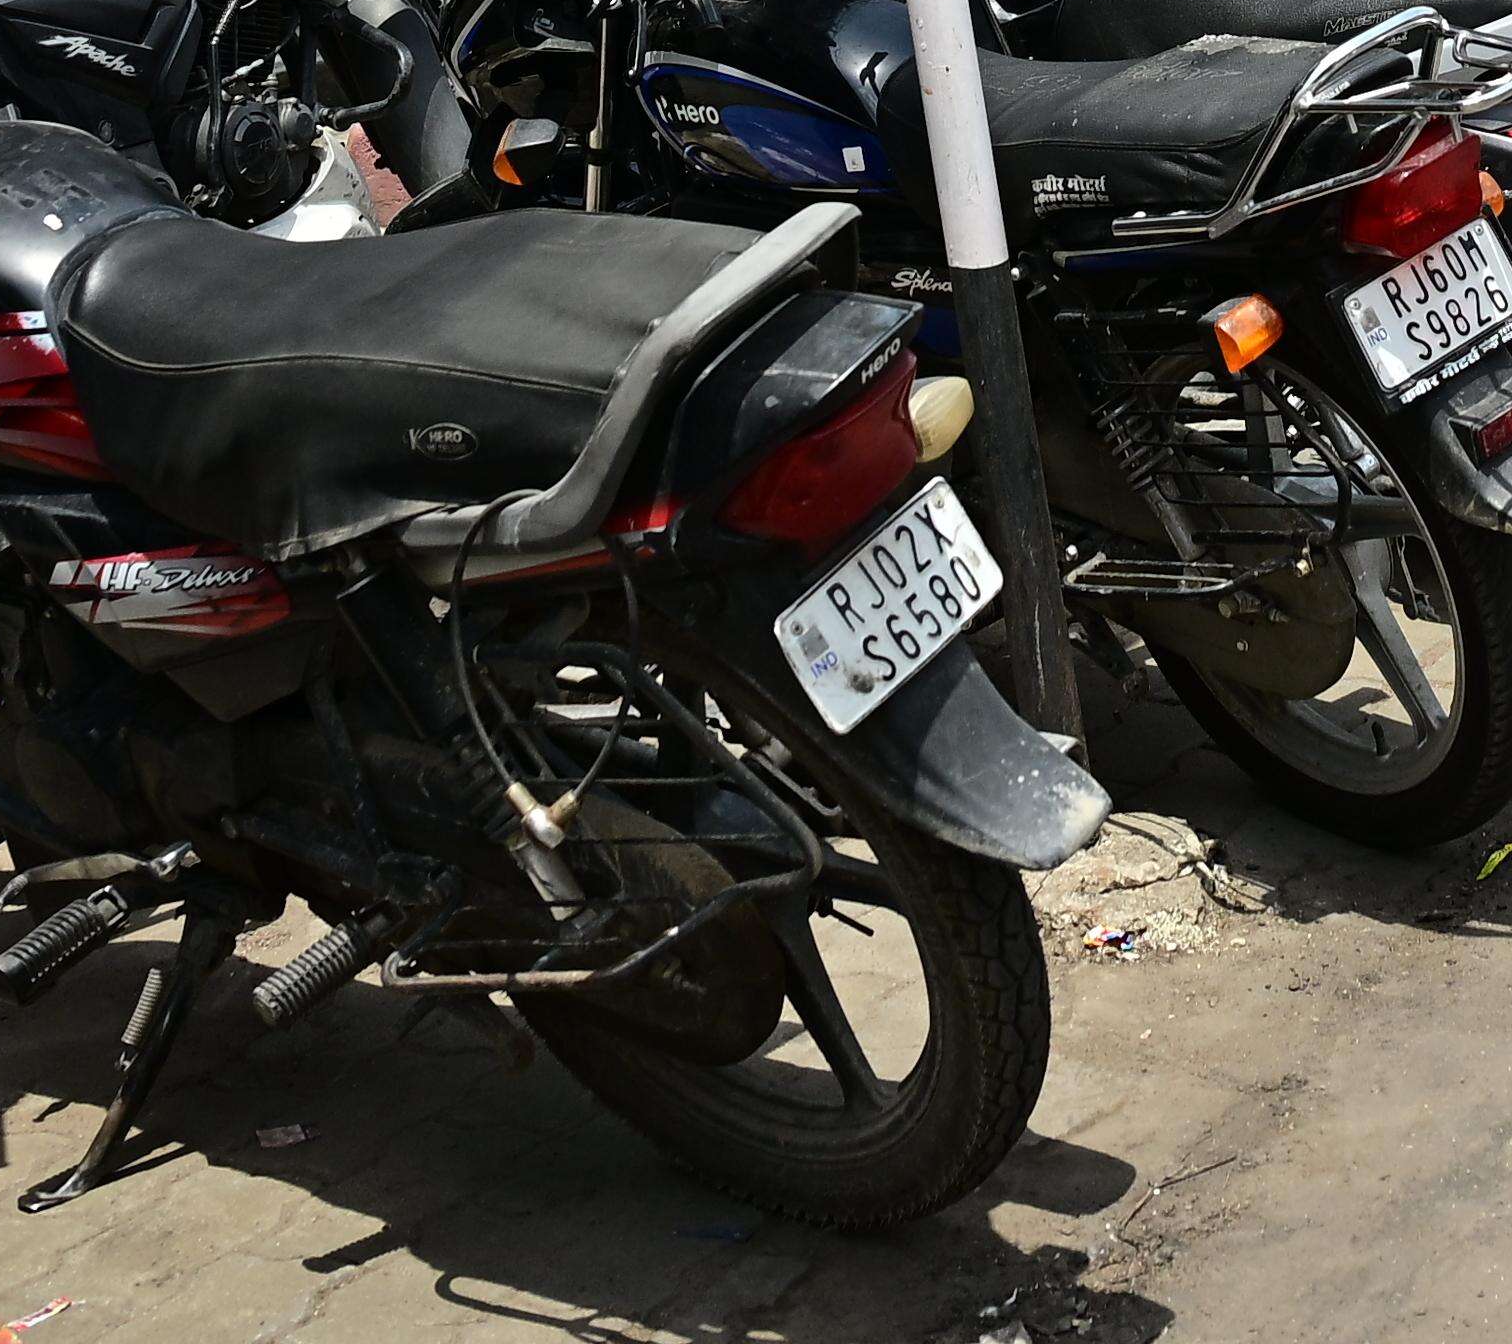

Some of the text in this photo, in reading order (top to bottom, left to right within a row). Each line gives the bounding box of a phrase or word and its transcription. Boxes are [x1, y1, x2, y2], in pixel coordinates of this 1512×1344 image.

[38, 35, 137, 77] Apache
[674, 103, 720, 125] Hero
[1381, 230, 1489, 319] RJ60M
[1366, 327, 1389, 349] IND
[1405, 275, 1510, 361] S9826
[860, 337, 902, 386] Hero
[862, 556, 982, 682] S6580
[810, 650, 840, 679] IND
